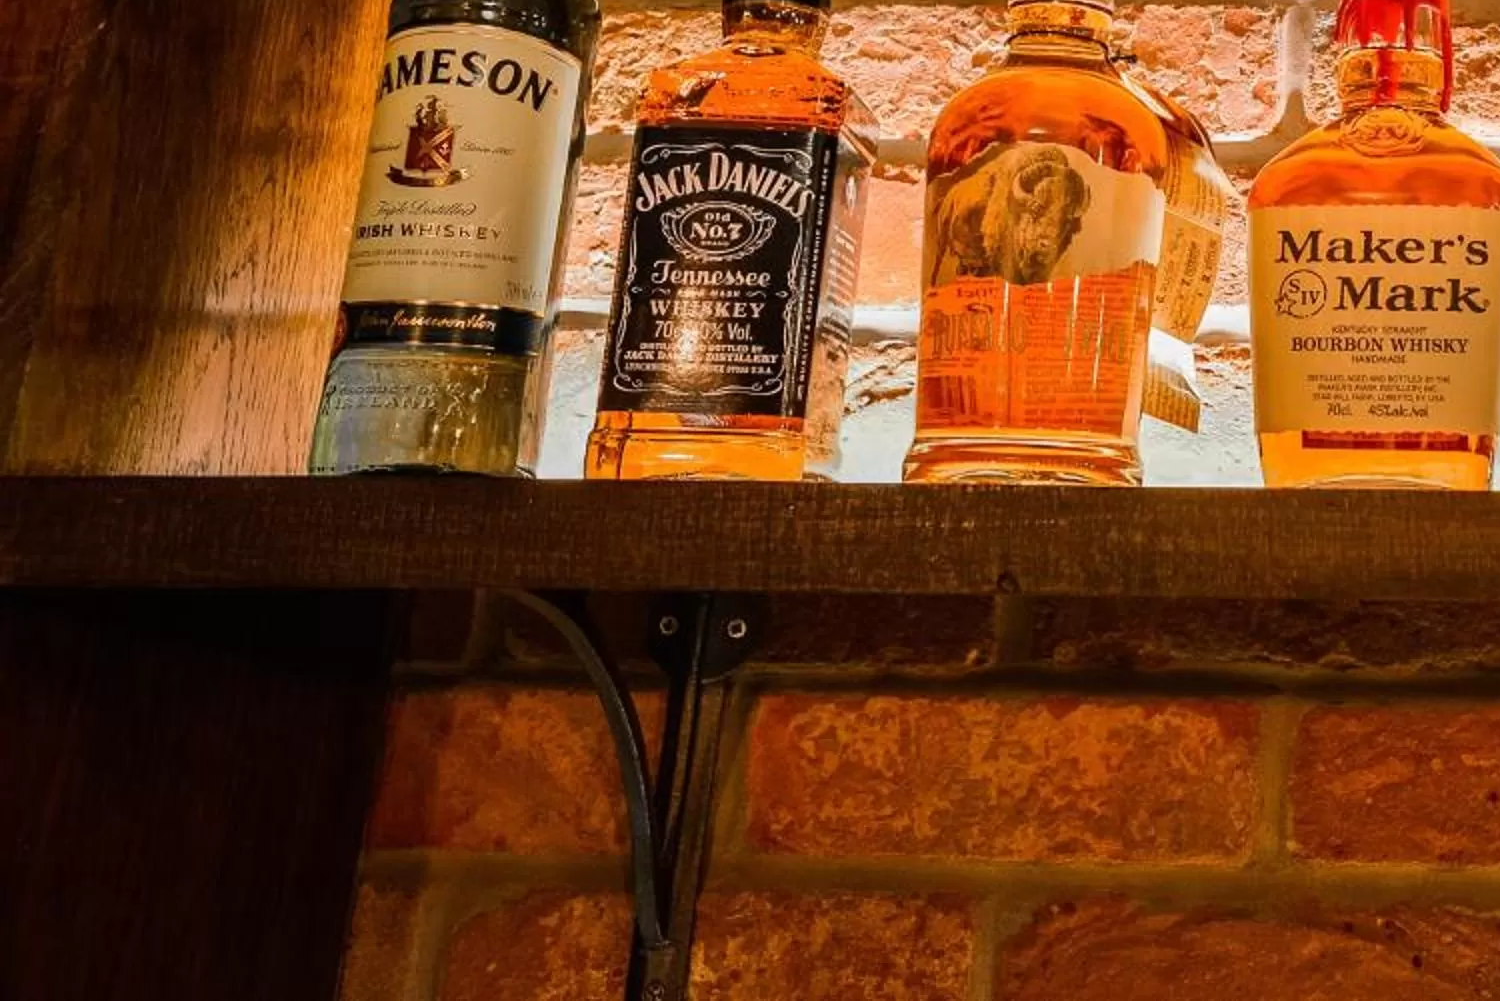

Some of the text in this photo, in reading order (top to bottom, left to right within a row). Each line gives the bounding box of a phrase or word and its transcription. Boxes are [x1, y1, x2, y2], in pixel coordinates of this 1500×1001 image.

[378, 49, 553, 112] AMESON
[635, 162, 704, 212] JACK
[704, 212, 731, 222] Old
[401, 222, 503, 241] WHISKEY
[690, 222, 743, 240] No.7
[1274, 229, 1489, 266] Maker's
[651, 260, 771, 287] Tennessee
[1289, 278, 1300, 294] S
[1332, 276, 1487, 314] Mark
[651, 300, 765, 318] WHISKEY
[728, 323, 753, 341] Vol.
[1292, 336, 1469, 354] BOURBON WHISKY
[623, 350, 655, 361] JACK
[706, 353, 779, 364] DISTILLERY
